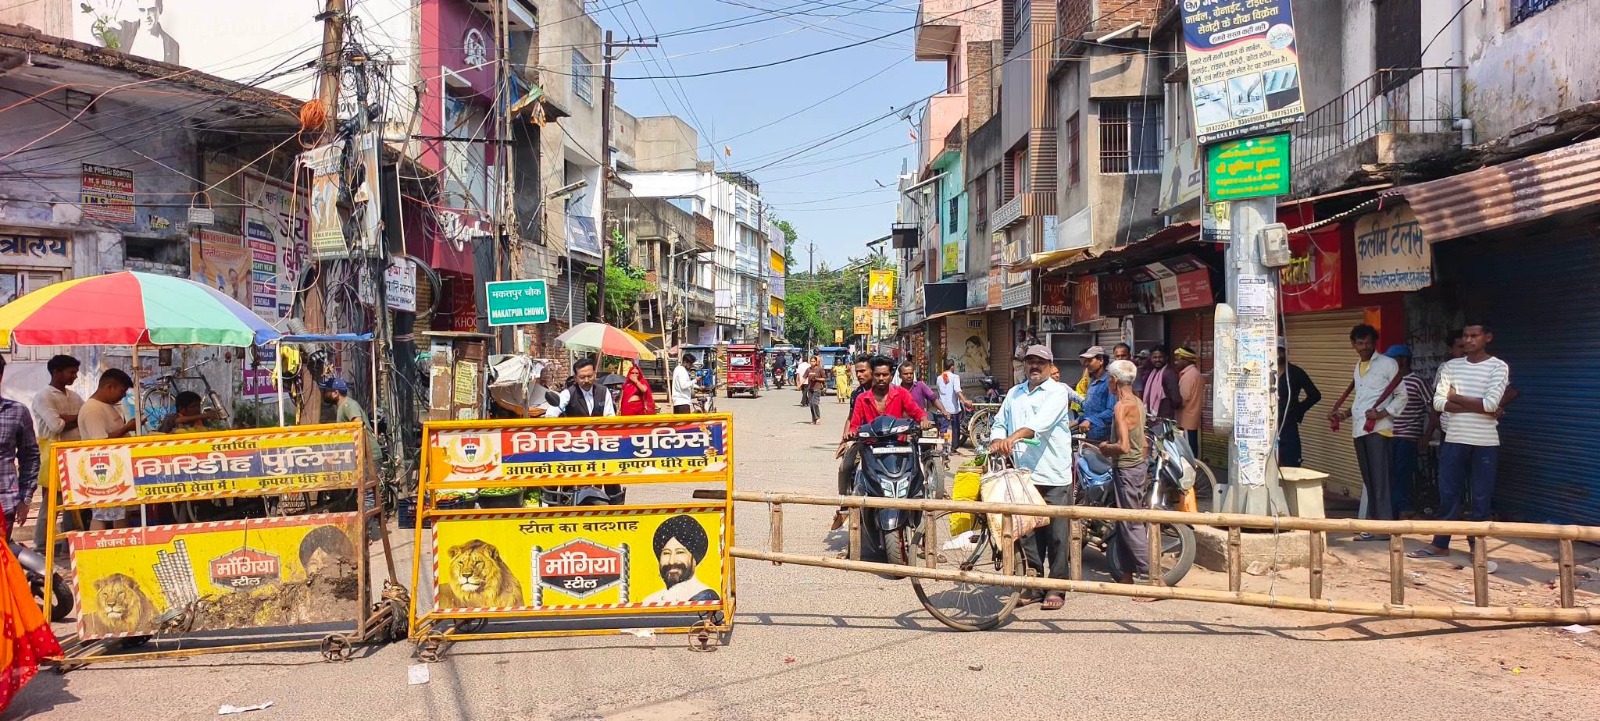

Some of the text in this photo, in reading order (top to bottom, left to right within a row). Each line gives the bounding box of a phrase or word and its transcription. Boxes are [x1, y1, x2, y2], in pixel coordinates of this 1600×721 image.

[1253, 6, 1279, 20] विक्रेता
[492, 290, 522, 300] मकतपुर
[492, 307, 545, 318] MAKATPUR CHOWK
[1042, 305, 1071, 315] FASHION
[510, 427, 711, 457] गिरिडीह पुलिस
[135, 447, 353, 477] गिरिडीह पुलिस
[506, 463, 552, 475] आपकी
[556, 463, 581, 473] सेवा
[586, 461, 597, 472] में
[618, 460, 655, 471] कृपया
[661, 457, 683, 468] धीरे
[687, 455, 708, 466] चलें
[145, 482, 187, 496] आपकी
[191, 480, 214, 493] सेवा
[217, 479, 228, 491] में
[258, 476, 294, 488] कृपया
[298, 474, 319, 483] धीरे
[518, 520, 640, 534] स्टील का बादशाह
[544, 551, 616, 574] मोंगिया
[231, 577, 261, 587] स्टील
[563, 577, 598, 589] स्टील
